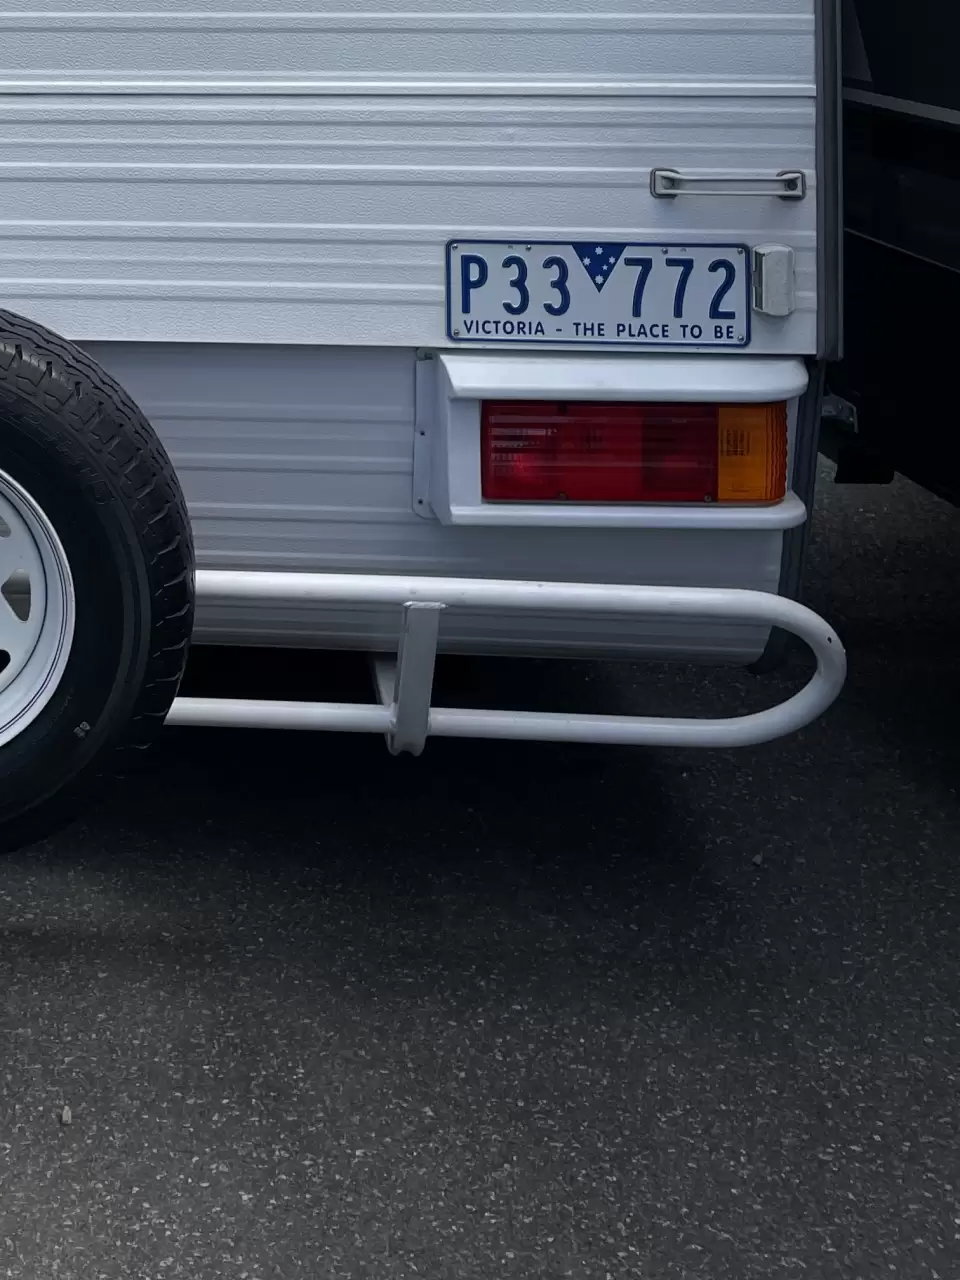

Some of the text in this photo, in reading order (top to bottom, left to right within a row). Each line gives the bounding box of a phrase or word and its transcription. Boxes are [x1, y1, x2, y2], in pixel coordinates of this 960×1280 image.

[460, 254, 736, 320] P33 772
[463, 320, 545, 336] VICTORIA
[573, 322, 606, 338] THE
[616, 323, 670, 339] PLACE
[680, 324, 703, 340] TO
[714, 325, 734, 340] BE
